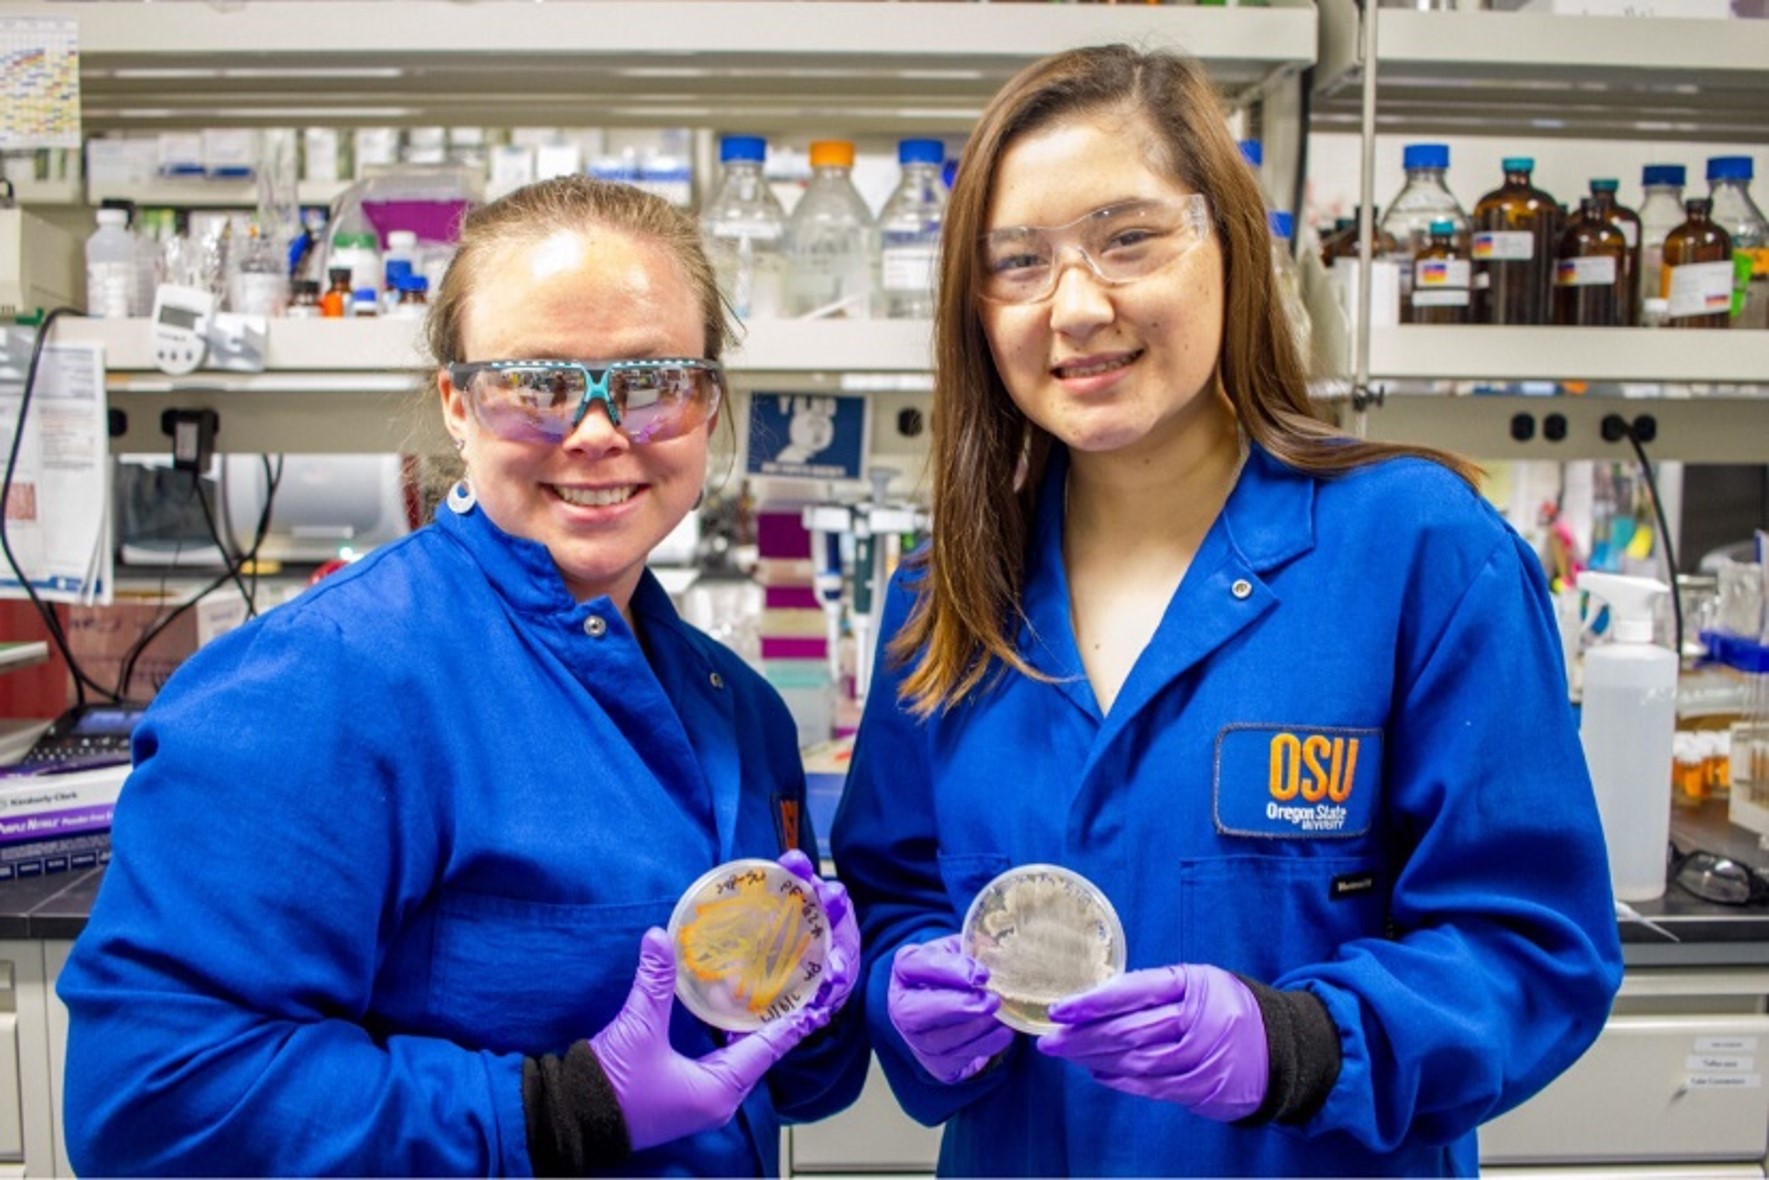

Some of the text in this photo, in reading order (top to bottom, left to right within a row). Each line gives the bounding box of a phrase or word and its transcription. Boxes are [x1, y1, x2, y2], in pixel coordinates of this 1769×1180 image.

[1269, 732, 1359, 802] OSU
[1266, 801, 1347, 824] Oregon State
